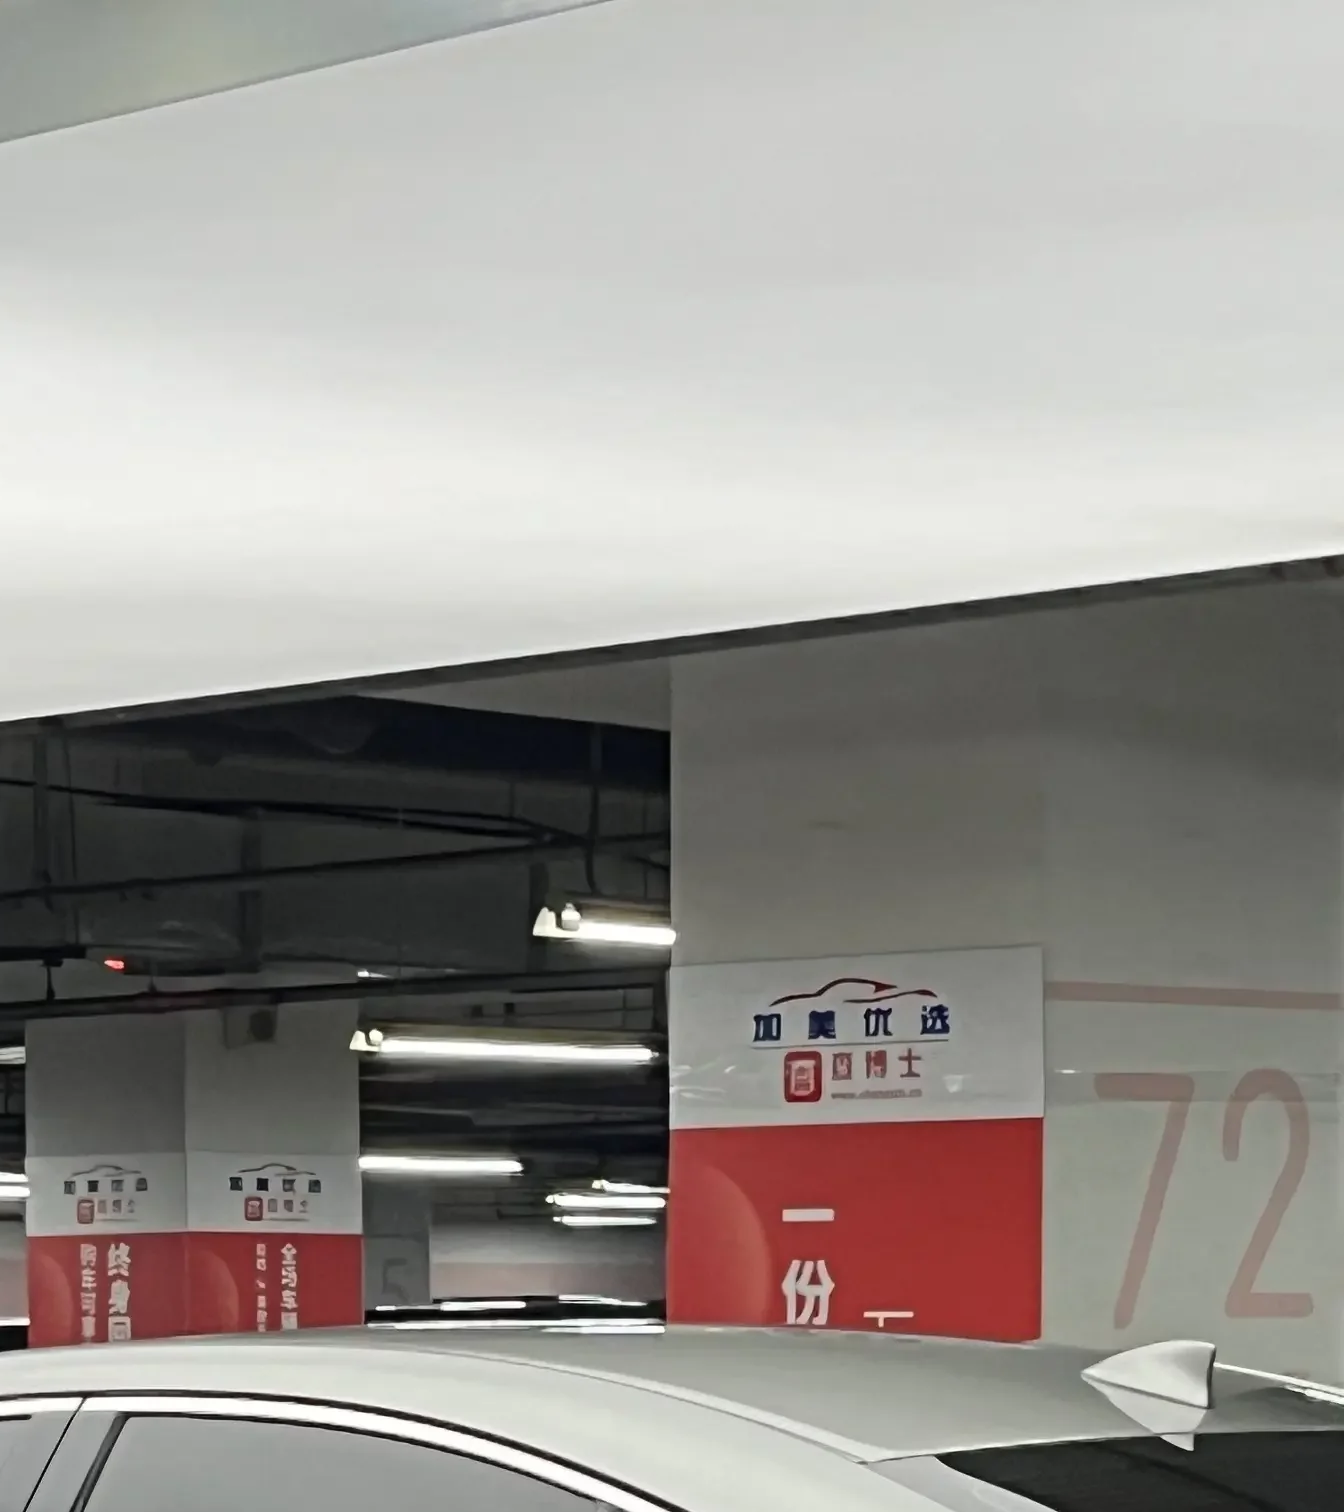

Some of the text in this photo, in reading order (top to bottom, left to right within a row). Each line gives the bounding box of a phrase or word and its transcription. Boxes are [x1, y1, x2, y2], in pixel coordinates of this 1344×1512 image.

[752, 1003, 951, 1043] 加美优选
[1094, 1068, 1313, 1330] 72
